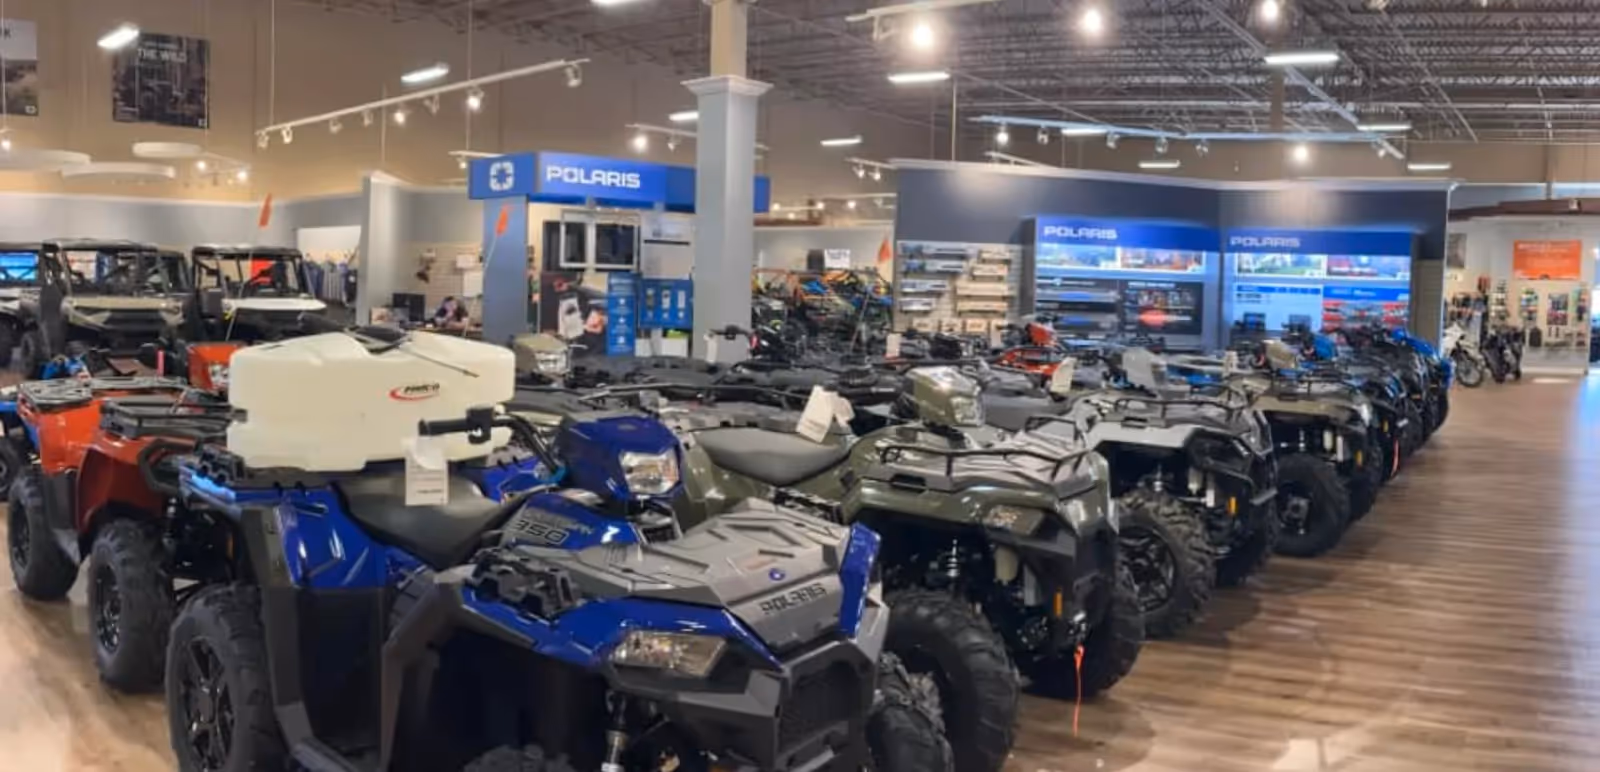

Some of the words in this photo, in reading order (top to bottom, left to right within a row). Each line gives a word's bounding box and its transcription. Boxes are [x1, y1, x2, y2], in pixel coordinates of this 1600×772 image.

[546, 165, 641, 189] POLARIS
[1043, 225, 1118, 240] POLARIS
[1230, 236, 1301, 248] POLARIS
[759, 582, 827, 615] POLARIS
